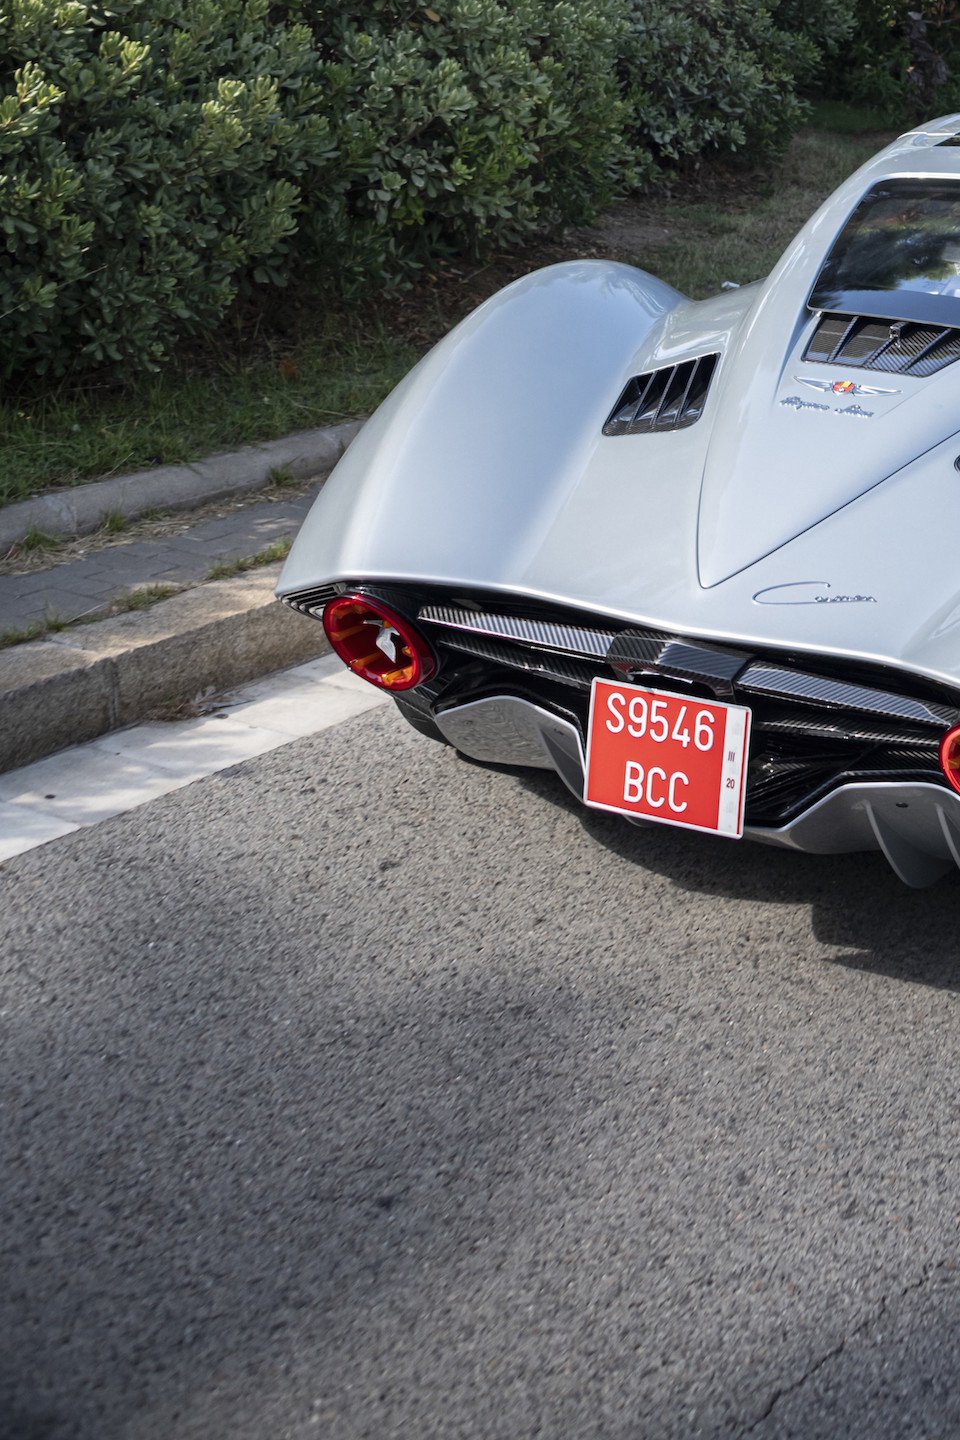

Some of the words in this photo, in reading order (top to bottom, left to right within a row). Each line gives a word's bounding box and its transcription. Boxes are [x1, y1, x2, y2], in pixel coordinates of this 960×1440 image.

[605, 692, 715, 751] S9546
[623, 761, 689, 813] BCC
[726, 778, 735, 789] 20
